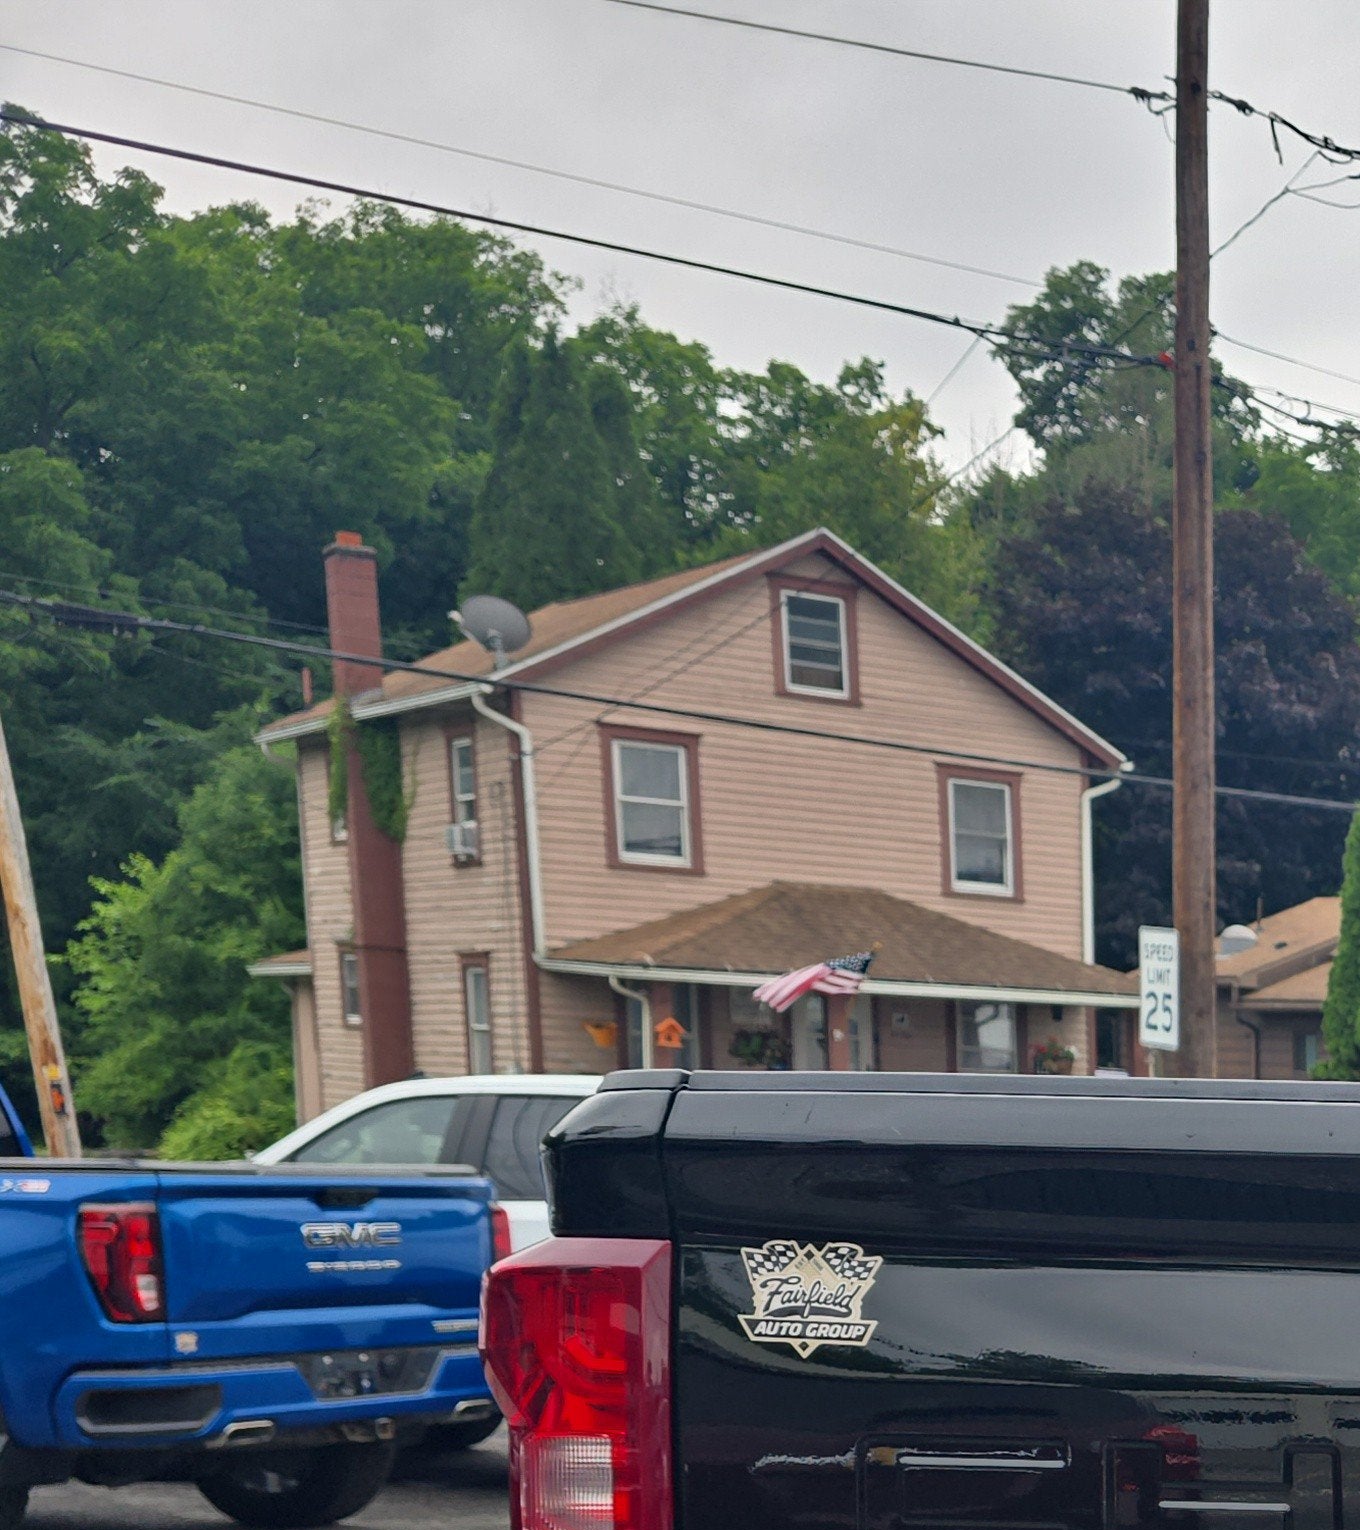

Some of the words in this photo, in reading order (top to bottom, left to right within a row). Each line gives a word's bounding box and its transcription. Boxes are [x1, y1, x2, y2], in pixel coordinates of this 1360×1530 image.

[1144, 942, 1174, 962] SPEED
[1146, 967, 1172, 985] LIMIT
[1145, 990, 1174, 1032] 25
[300, 1222, 402, 1249] GMC
[760, 1275, 862, 1318] Fairfield
[753, 1321, 802, 1337] AUTO
[805, 1323, 867, 1340] GROUP
